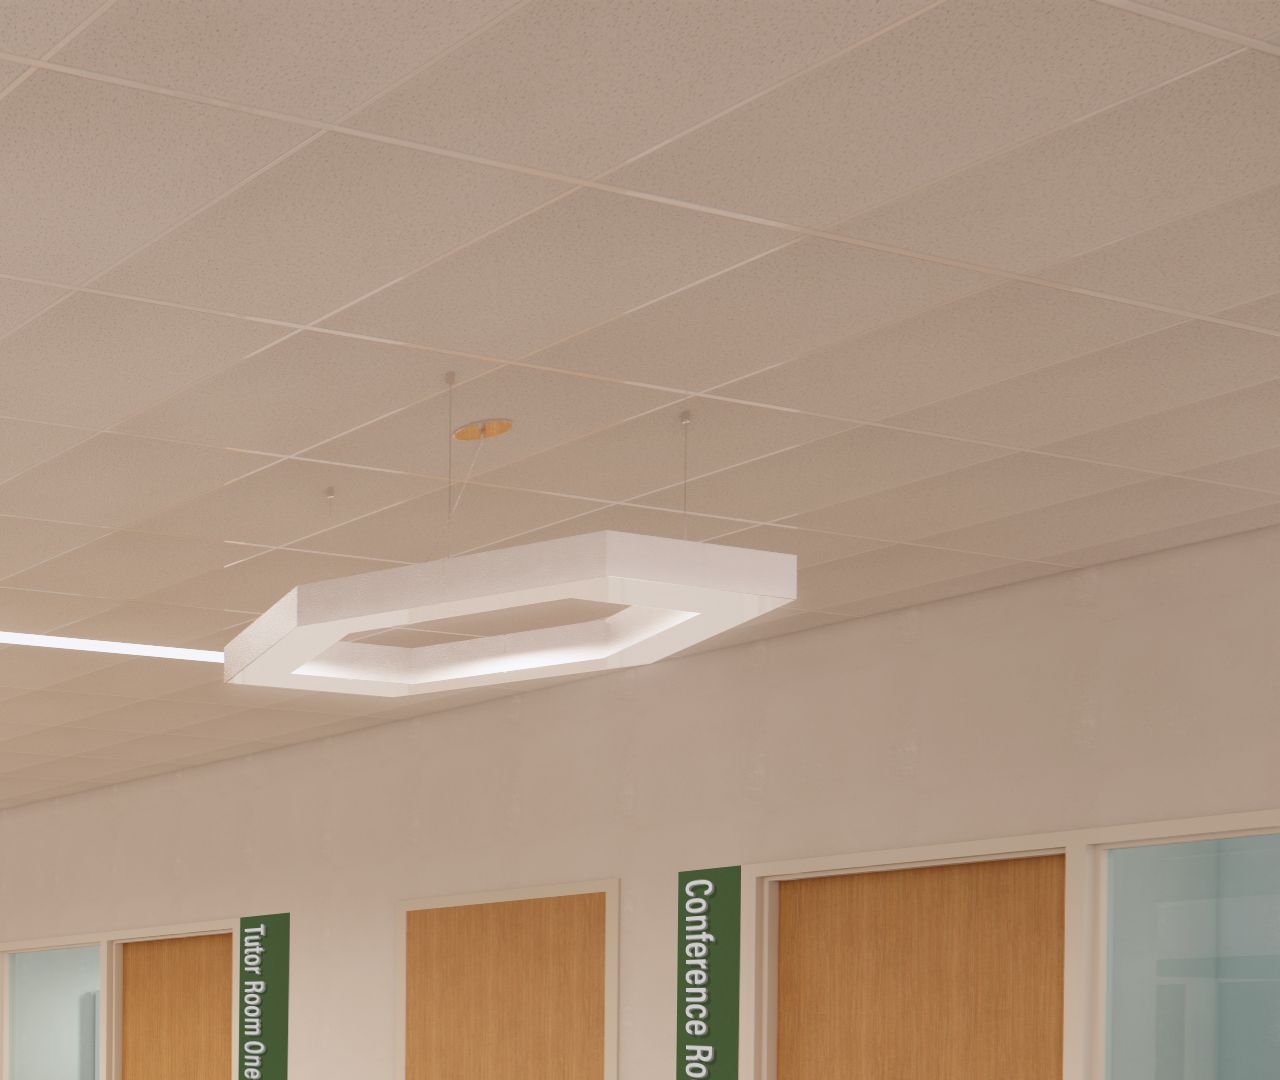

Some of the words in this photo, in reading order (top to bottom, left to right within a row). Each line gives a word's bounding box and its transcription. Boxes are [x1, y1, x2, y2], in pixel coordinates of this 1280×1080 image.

[244, 924, 266, 975] Tutor
[685, 879, 715, 1035] Conference
[244, 981, 266, 1036] Room
[244, 1041, 266, 1080] One
